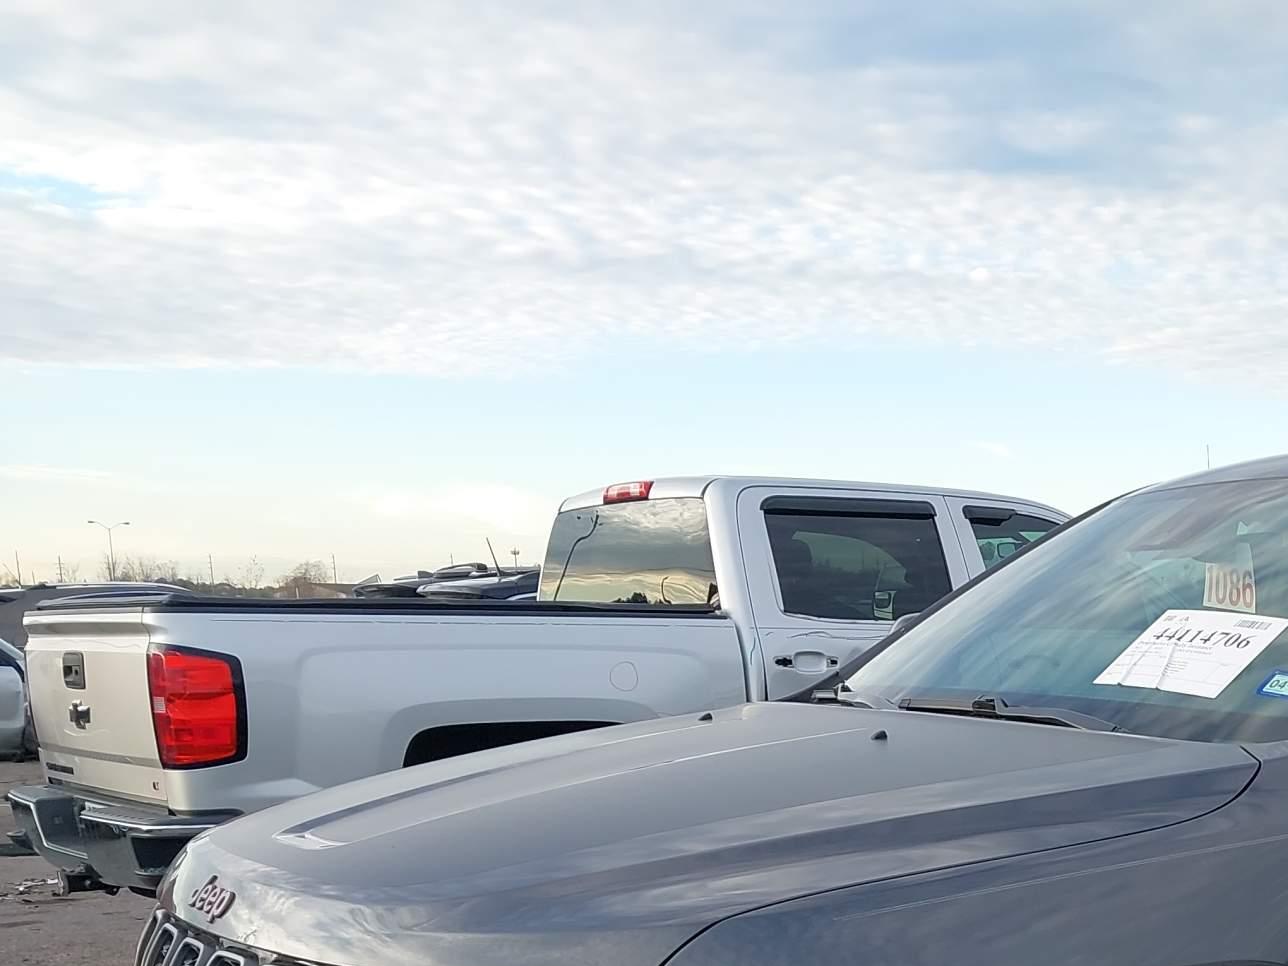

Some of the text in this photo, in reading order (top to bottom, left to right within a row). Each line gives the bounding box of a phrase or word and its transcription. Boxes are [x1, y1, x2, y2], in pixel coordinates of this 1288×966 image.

[1207, 565, 1254, 609] 1086
[1152, 627, 1257, 649] 44114706
[188, 875, 236, 924] Jeep
